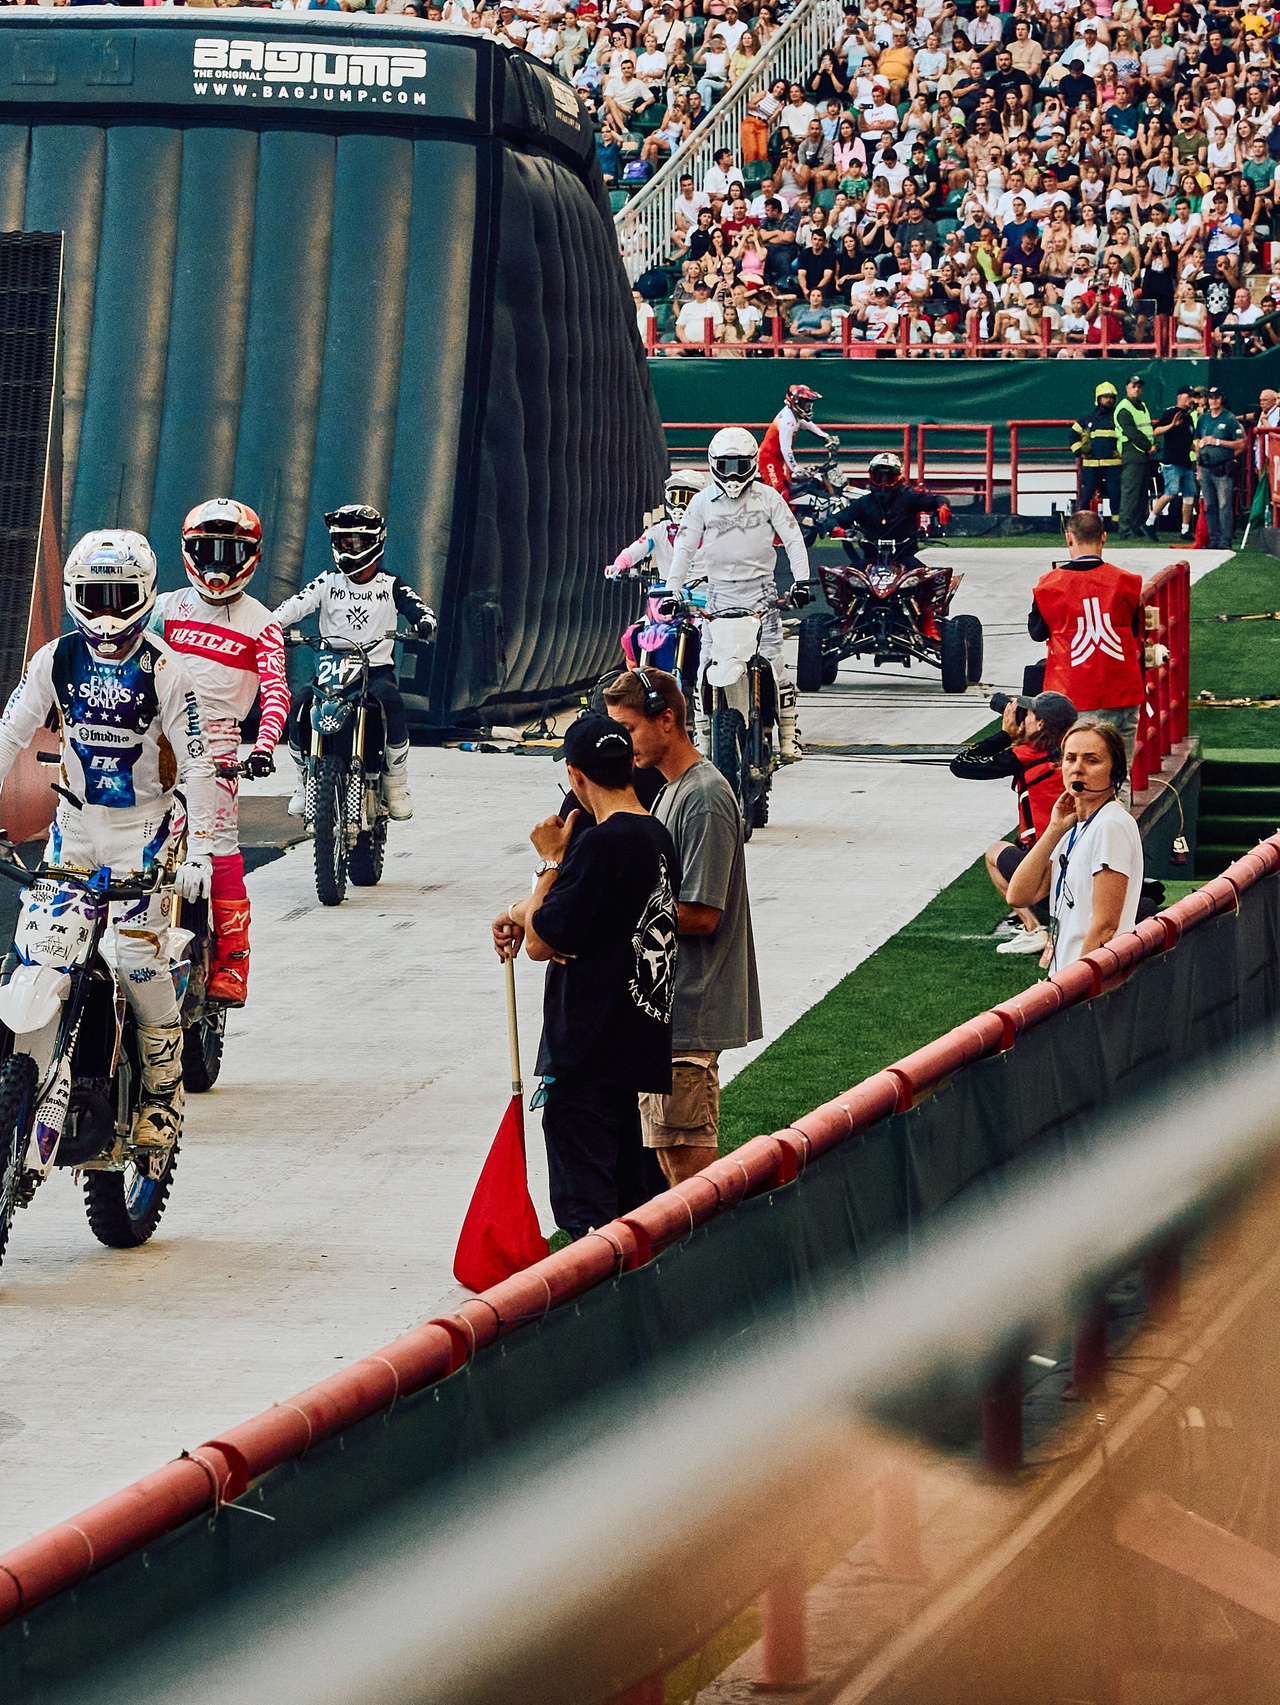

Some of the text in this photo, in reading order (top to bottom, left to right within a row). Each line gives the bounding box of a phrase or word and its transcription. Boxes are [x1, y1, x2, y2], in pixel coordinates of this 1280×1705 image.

[193, 38, 427, 87] BAGJUMP
[193, 69, 263, 81] THE ORIGINAL
[193, 82, 427, 105] WWW.BAGJUMP.COM
[317, 659, 363, 686] 247
[79, 683, 132, 703] SENDS
[87, 697, 118, 710] ONLY
[90, 756, 121, 770] FK
